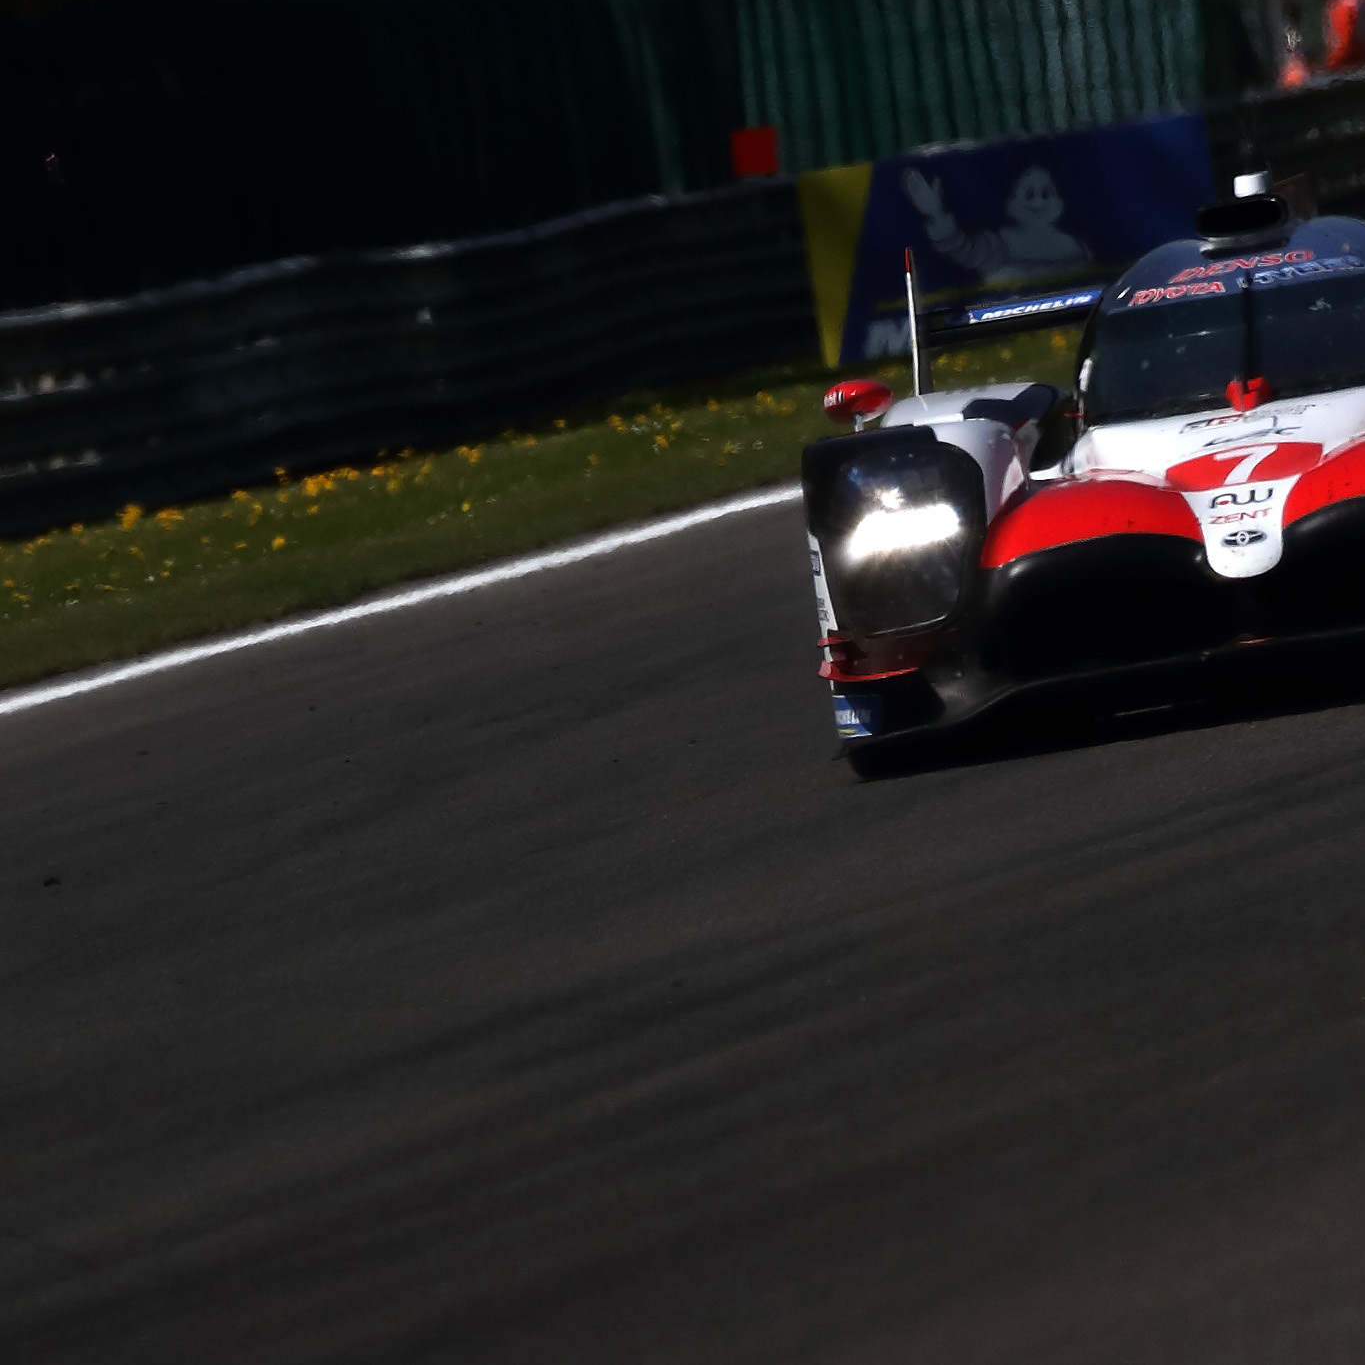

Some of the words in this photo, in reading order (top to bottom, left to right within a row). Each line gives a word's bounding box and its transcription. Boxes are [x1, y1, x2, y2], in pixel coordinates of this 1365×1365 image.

[1169, 249, 1315, 284] DENSO
[1213, 443, 1279, 485] 7
[1208, 507, 1273, 525] ZENT
